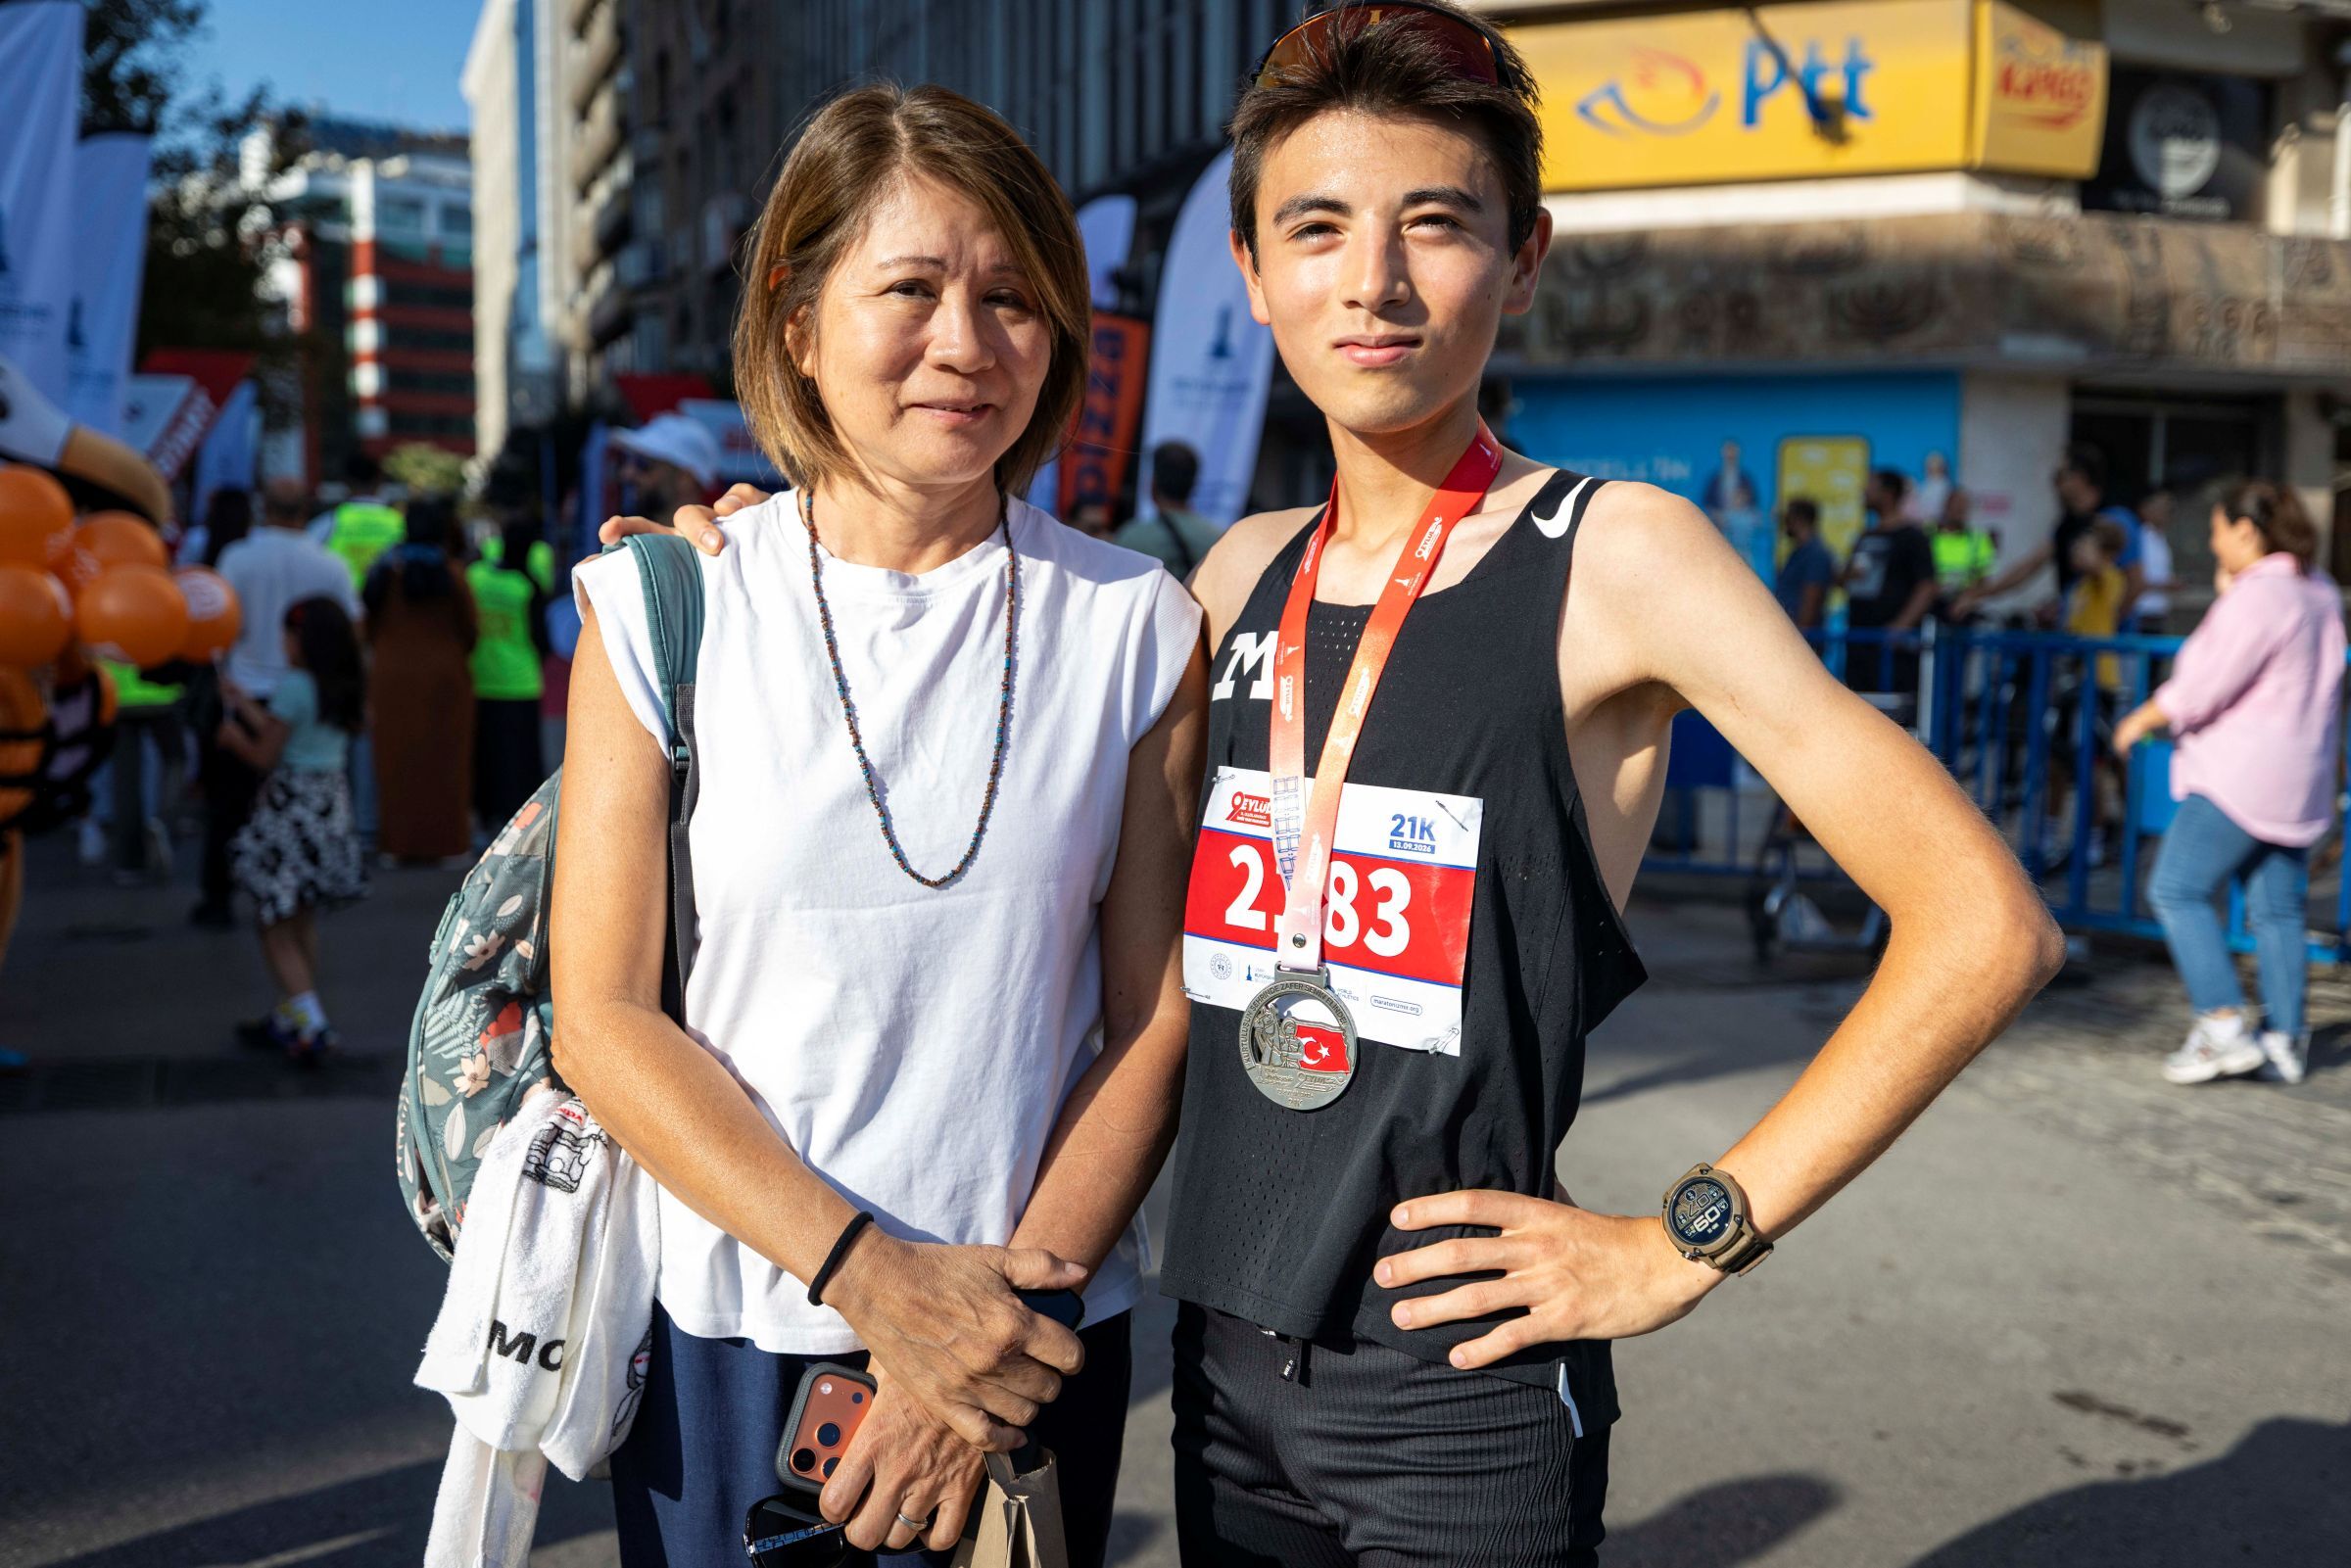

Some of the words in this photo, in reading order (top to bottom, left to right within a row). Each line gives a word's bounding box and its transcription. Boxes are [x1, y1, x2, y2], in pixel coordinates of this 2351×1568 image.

[1212, 630, 1279, 702] M
[1390, 813, 1436, 842] 21K
[1224, 844, 1412, 957] 283
[1280, 982, 1304, 991] ZAFER
